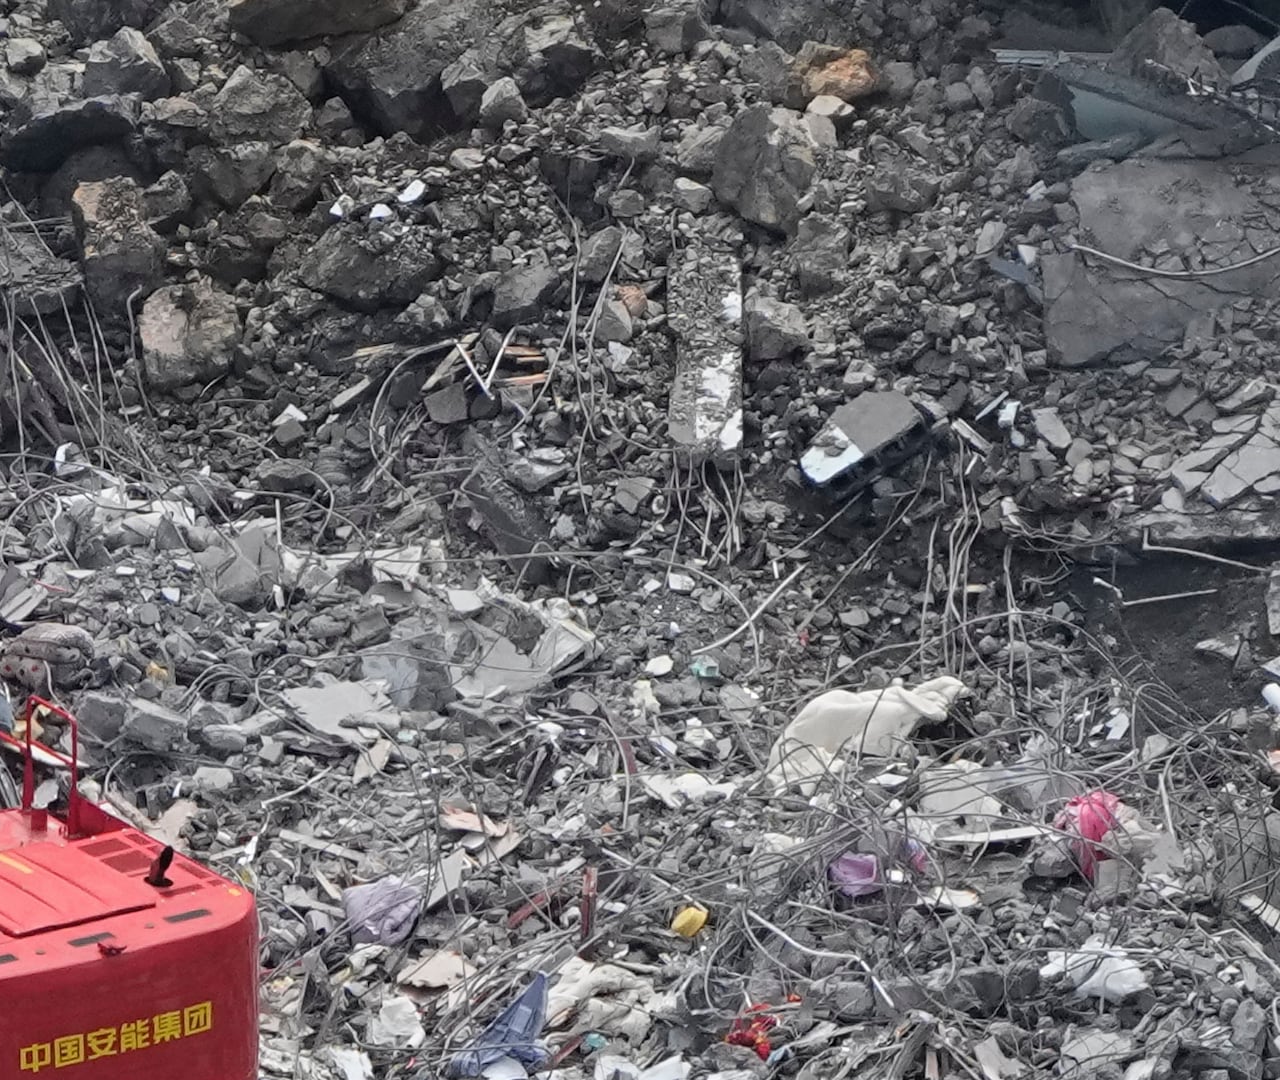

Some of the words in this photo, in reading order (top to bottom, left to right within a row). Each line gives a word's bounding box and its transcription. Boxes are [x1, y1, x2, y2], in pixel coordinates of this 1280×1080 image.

[19, 1001, 212, 1073] 中国安能集团
